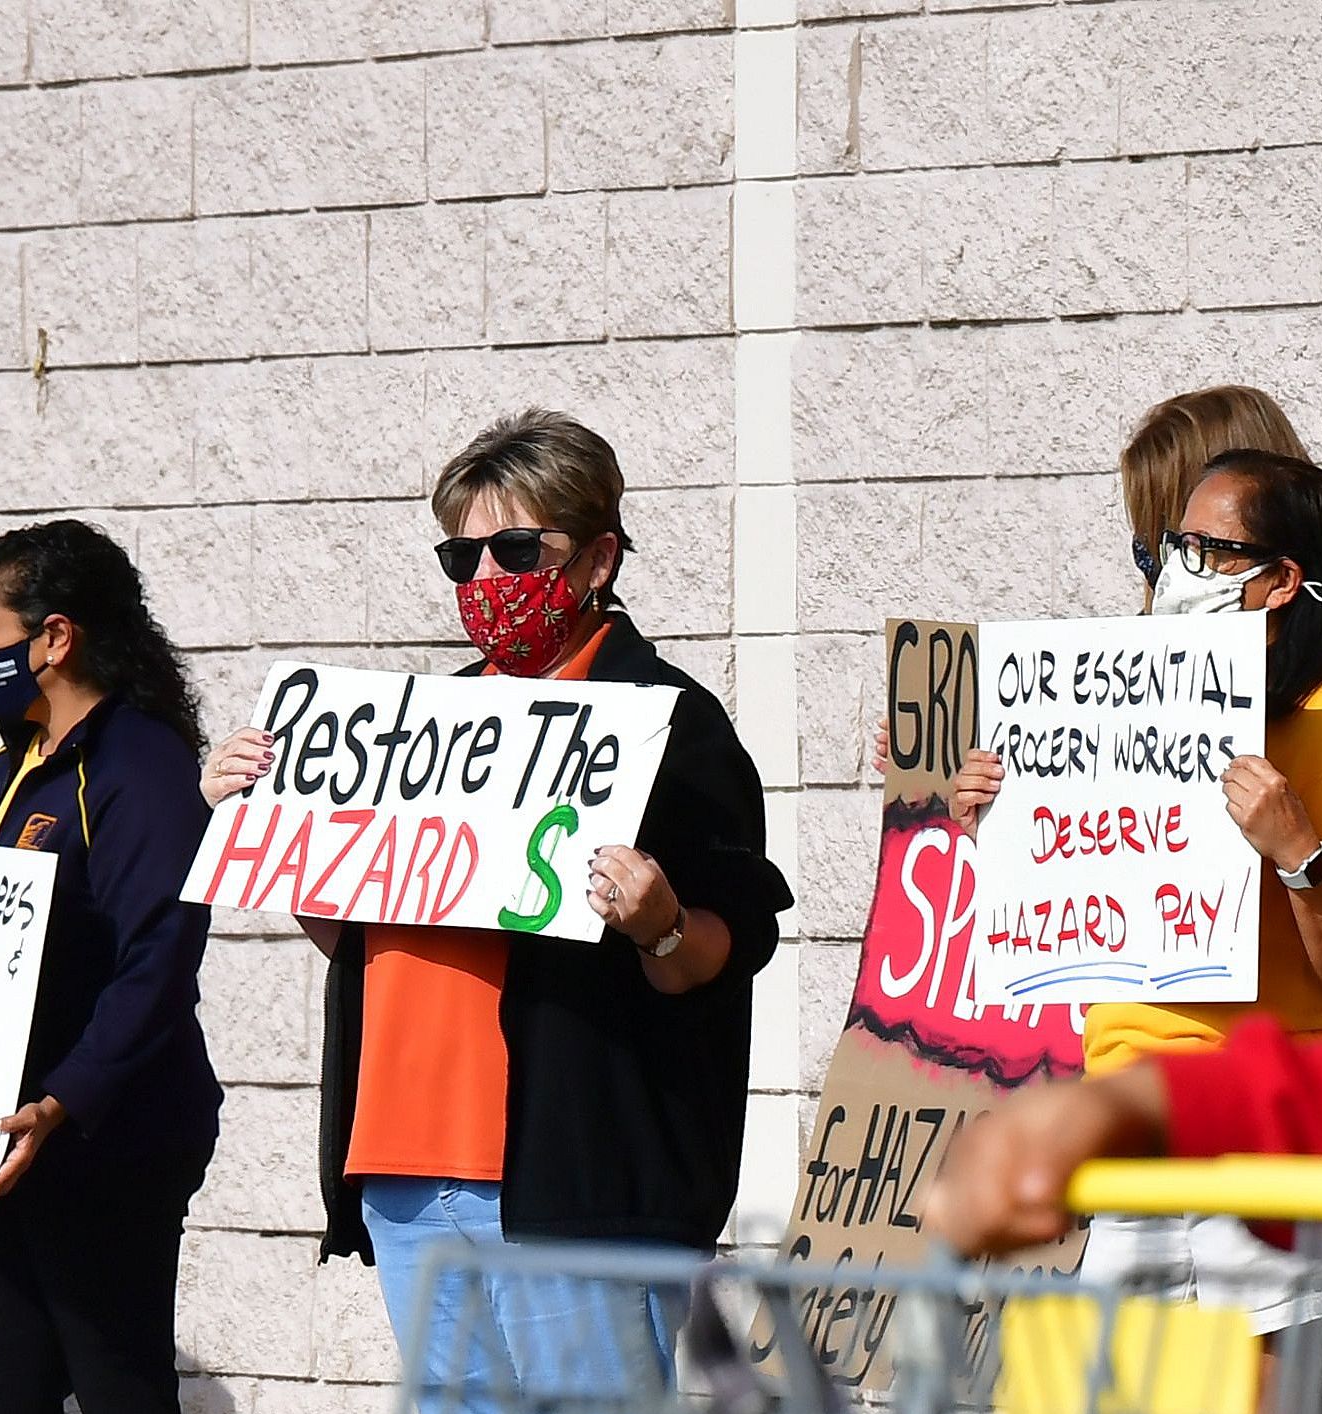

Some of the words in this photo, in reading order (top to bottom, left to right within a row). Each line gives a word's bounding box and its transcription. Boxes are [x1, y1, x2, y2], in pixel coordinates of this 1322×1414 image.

[998, 651, 1058, 708] OUR
[1074, 644, 1253, 713] ESSENTIAL
[245, 667, 503, 807] Restore
[513, 700, 620, 810] The
[989, 721, 1100, 783] GROCERY
[1114, 724, 1236, 784] WORKERS
[206, 802, 480, 925] HAZARD
[1031, 804, 1189, 864] DESERVE
[986, 894, 1127, 955] HAZARD
[1155, 866, 1252, 955] PAY!
[801, 1105, 856, 1223] for
